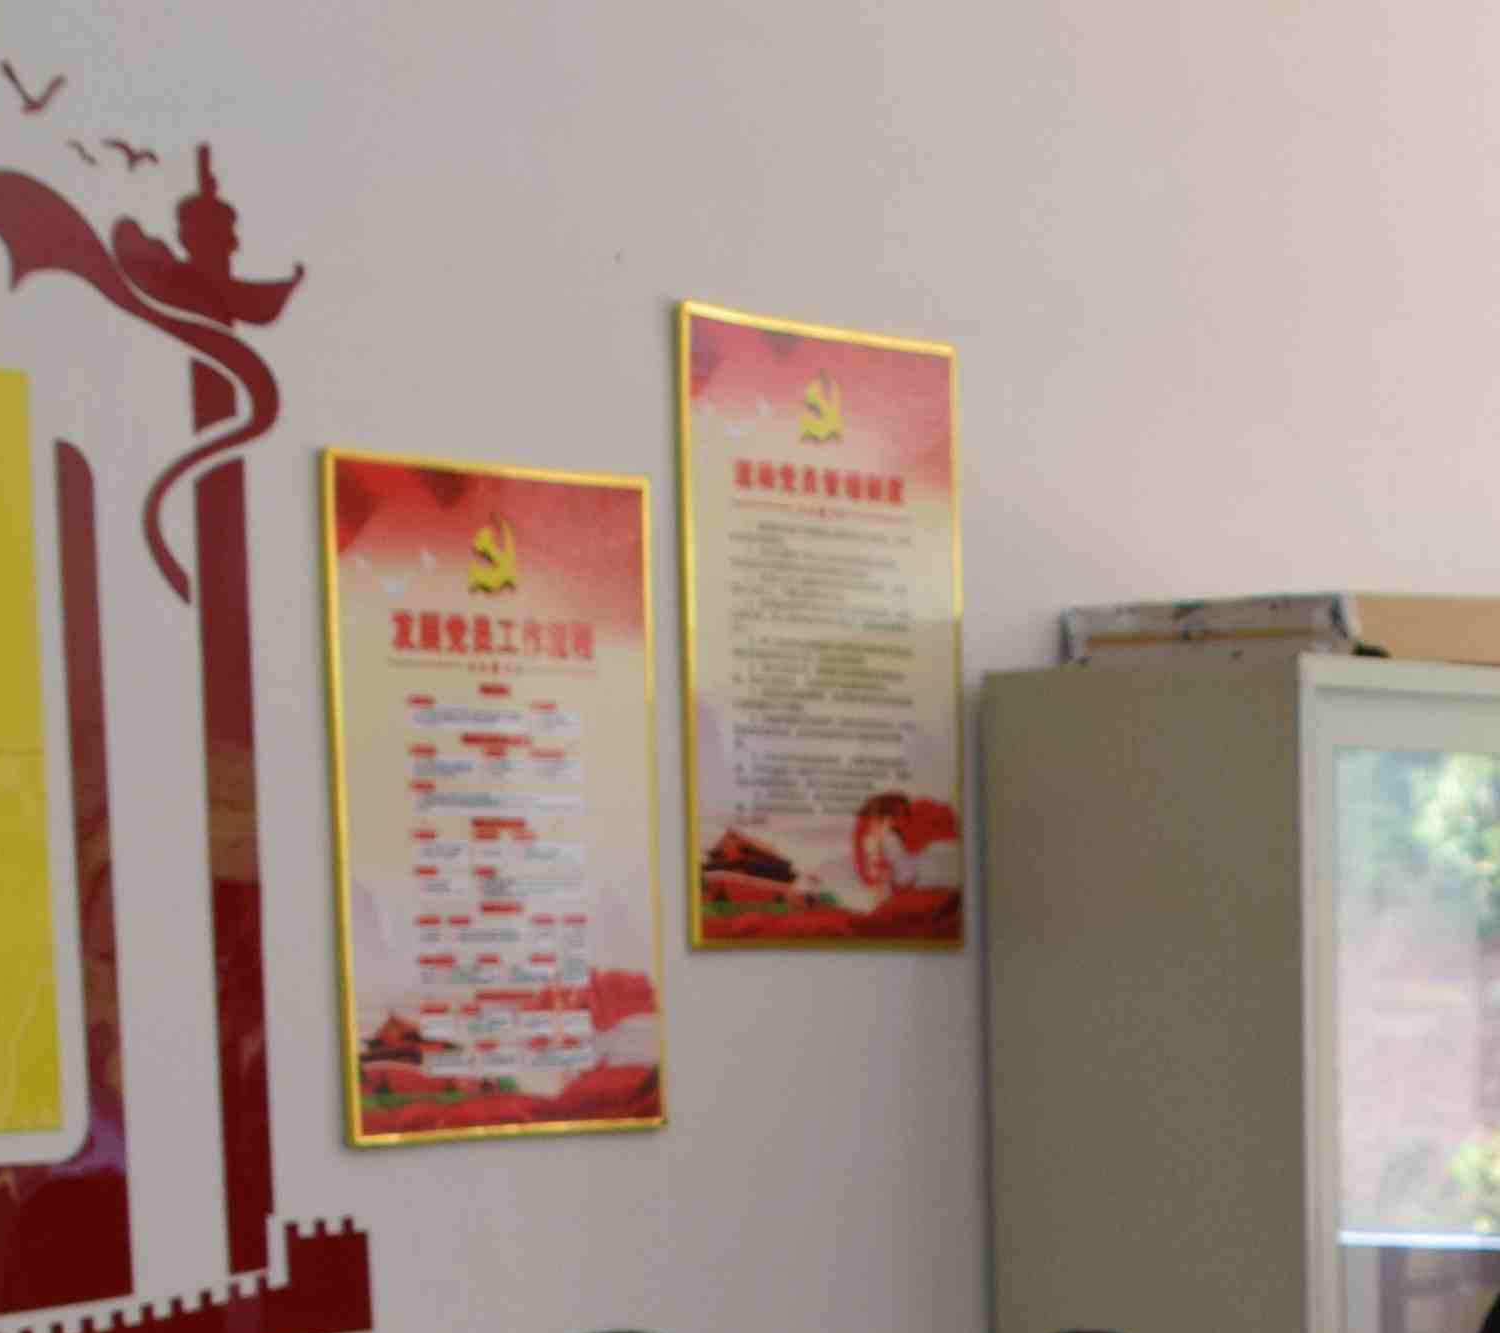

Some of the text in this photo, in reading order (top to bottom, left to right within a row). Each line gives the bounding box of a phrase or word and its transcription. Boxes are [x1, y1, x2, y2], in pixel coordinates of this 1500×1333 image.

[389, 610, 595, 661] 发展党员工作流程
